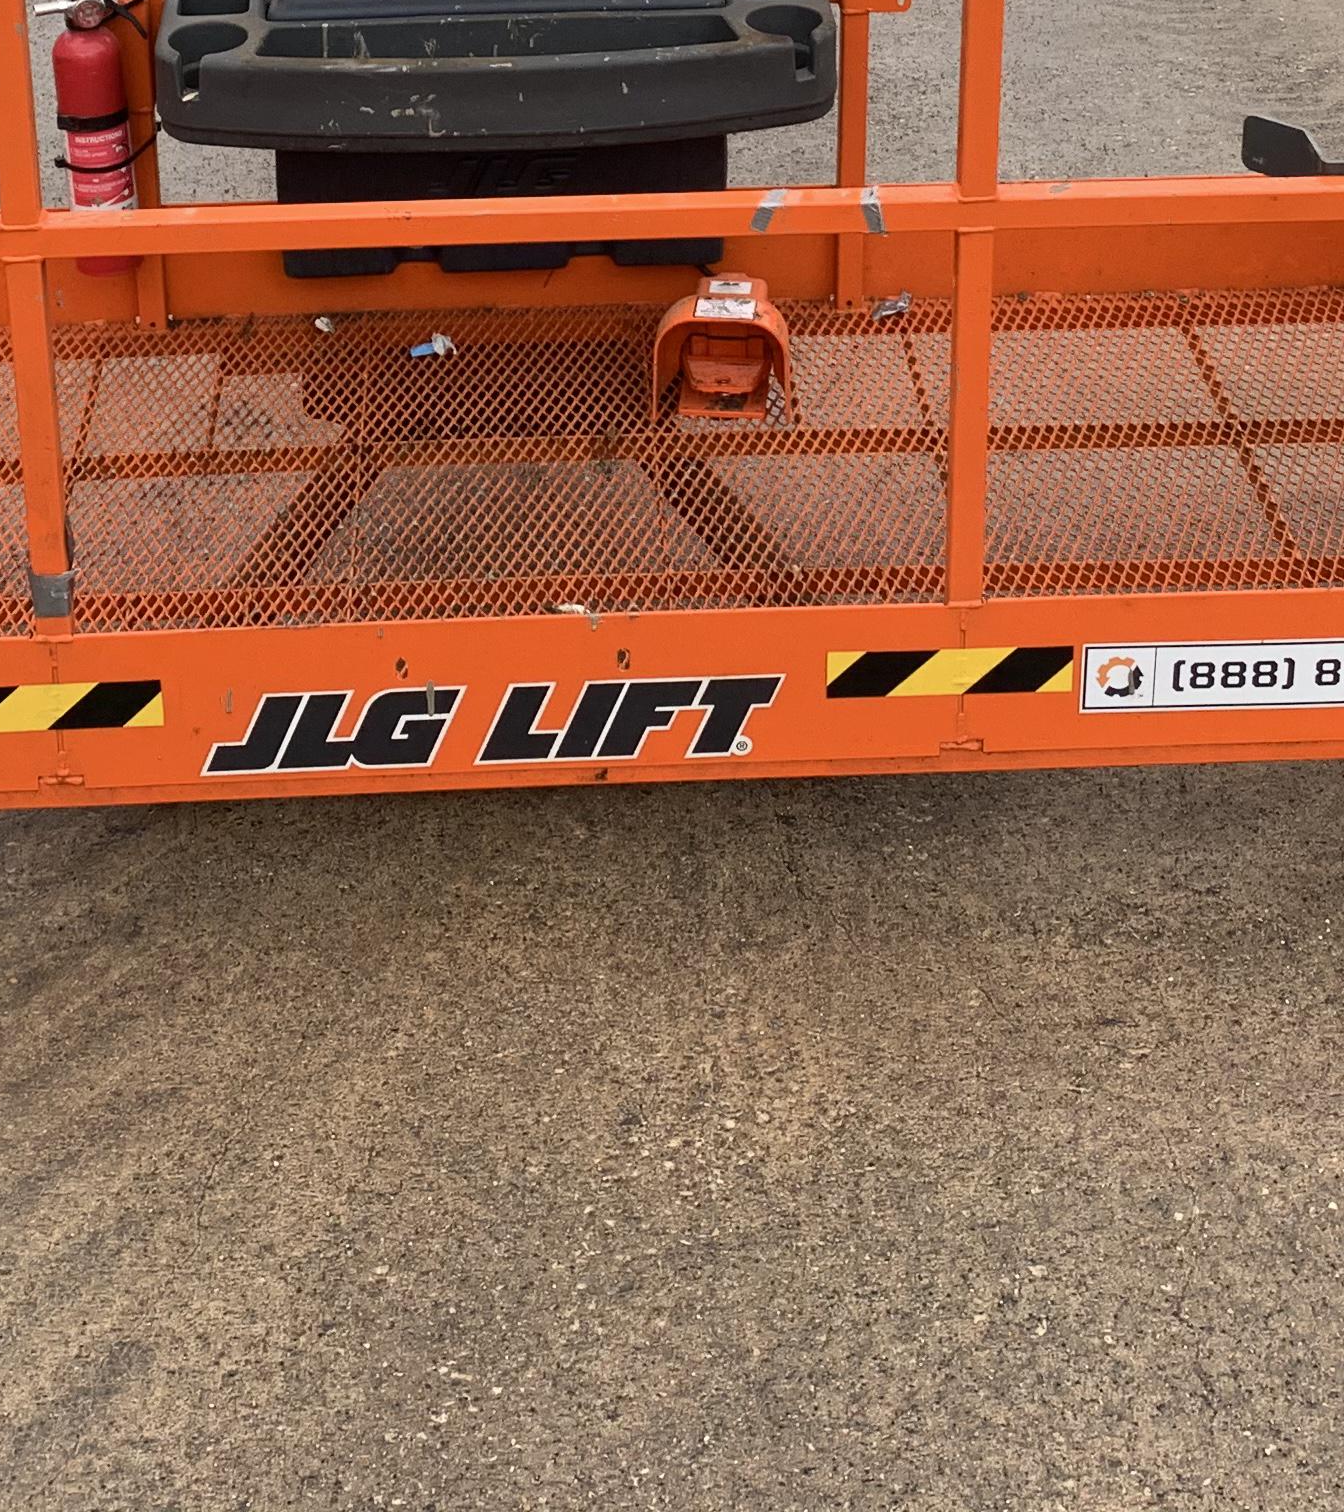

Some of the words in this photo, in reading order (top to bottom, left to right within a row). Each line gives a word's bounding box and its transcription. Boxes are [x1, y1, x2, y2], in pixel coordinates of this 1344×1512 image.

[1172, 657, 1296, 692] (888)
[201, 685, 467, 777] JLG
[473, 673, 787, 766] LIFT
